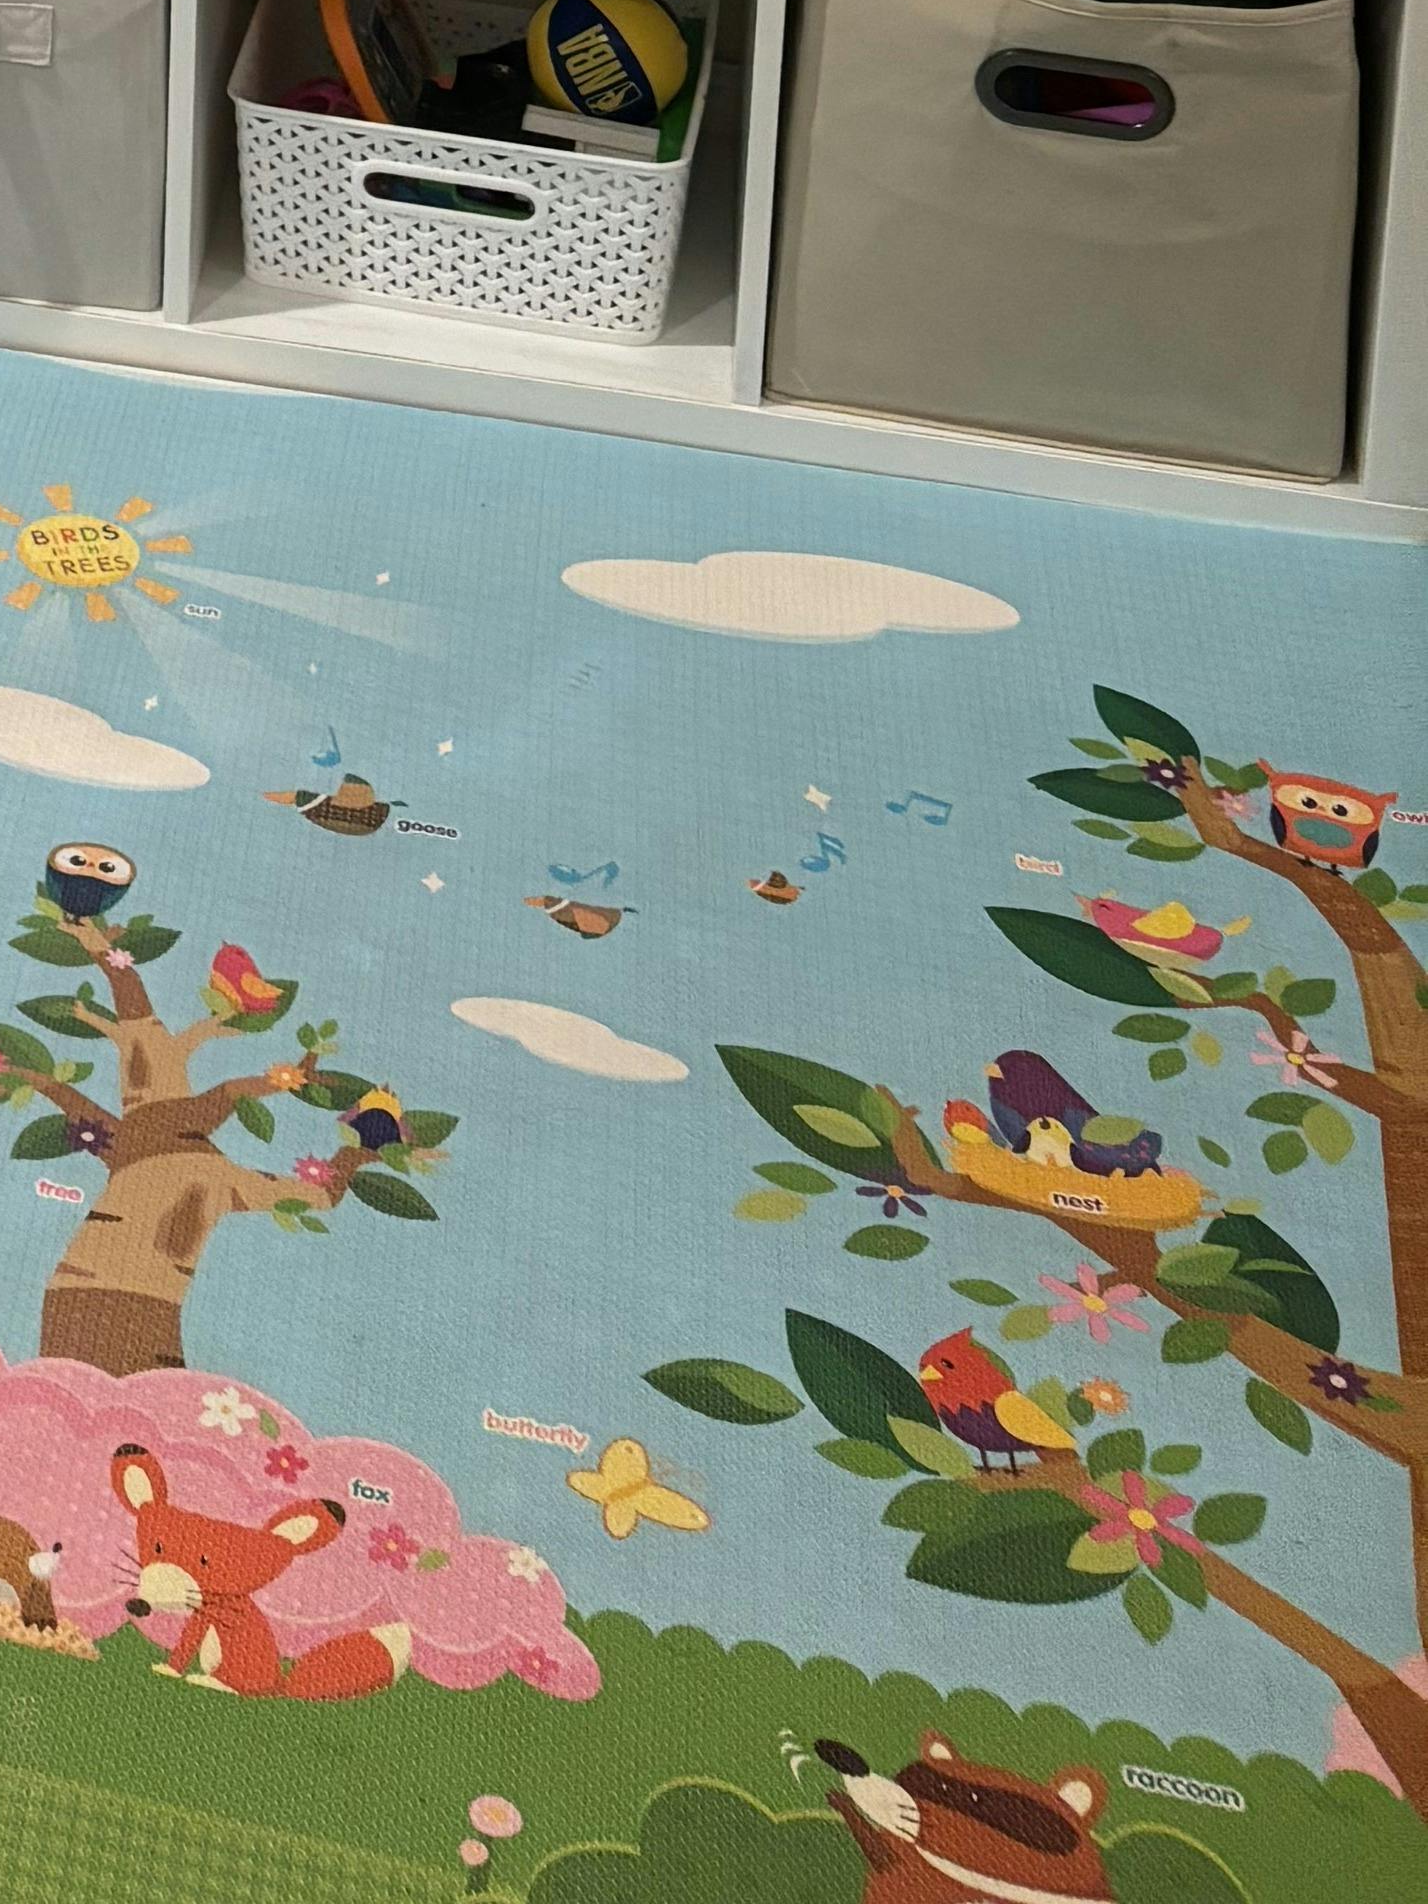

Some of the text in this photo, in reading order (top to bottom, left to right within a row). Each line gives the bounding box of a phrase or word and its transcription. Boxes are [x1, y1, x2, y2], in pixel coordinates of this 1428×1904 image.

[556, 23, 629, 96] NBA
[31, 524, 120, 545] BIRDS
[43, 555, 130, 575] TREES
[187, 605, 218, 617] sun
[397, 820, 458, 838] goose
[39, 1181, 82, 1201] tree
[1052, 1193, 1104, 1212] nest
[486, 1411, 588, 1451] butterfly
[352, 1478, 392, 1504] fox
[1126, 1768, 1241, 1808] raccoon
